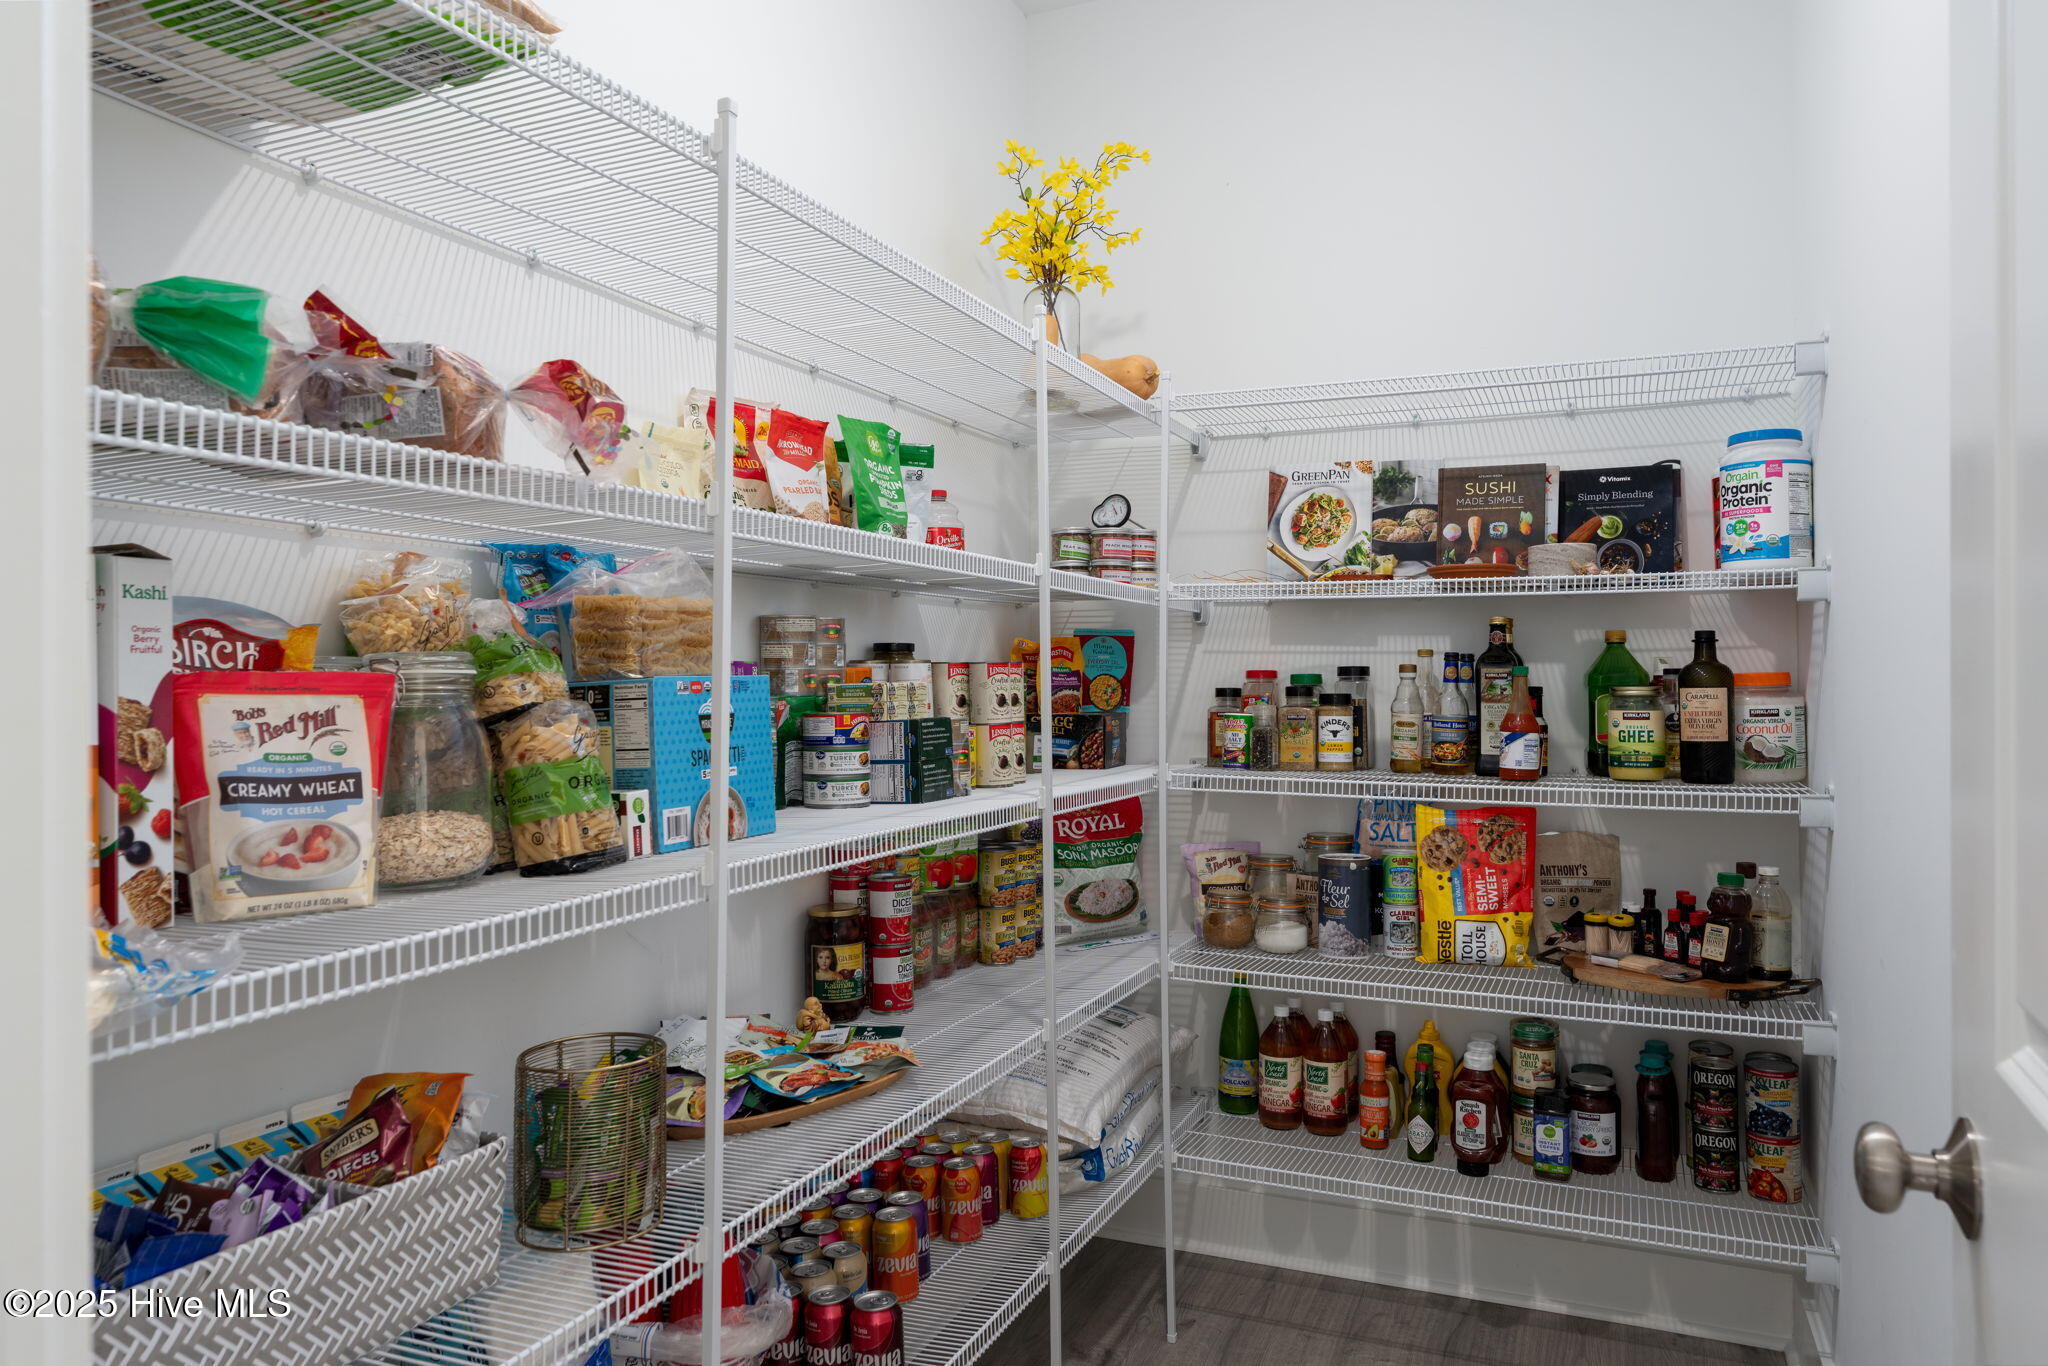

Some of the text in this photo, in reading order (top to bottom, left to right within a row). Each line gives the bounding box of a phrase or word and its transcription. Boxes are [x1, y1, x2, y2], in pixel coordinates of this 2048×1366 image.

[1726, 470, 1760, 484] Orgain
[1465, 481, 1516, 495] SUSHI
[1720, 480, 1773, 498] Organic
[1456, 496, 1524, 506] MADE SIMPLE
[1578, 490, 1654, 502] Simply Blending
[1722, 494, 1769, 510] Protein
[936, 533, 960, 545] Orville
[122, 584, 168, 600] Kashi
[130, 625, 161, 634] Organic
[132, 634, 160, 645] Berry
[130, 645, 163, 654] Fruitful
[255, 704, 338, 748] Red Mill
[1736, 722, 1792, 734] Coconut Oil
[1283, 729, 1310, 740] Organic
[1618, 730, 1654, 743] GHEE
[268, 754, 308, 762] ORGANIC
[246, 765, 332, 774] READY IN 5 MINUTES
[227, 778, 356, 798] CREAMY WHEAT
[261, 804, 326, 816] HOT CEREAL
[1056, 813, 1126, 839] ROYAL
[1369, 822, 1417, 842] SALT
[1091, 840, 1126, 848] ORGANIC
[1057, 848, 1088, 861] SONA
[1212, 856, 1242, 872] Red Mill
[1540, 864, 1588, 876] ANTHONY'S
[1320, 878, 1350, 894] Fleur
[1485, 868, 1498, 910] SWEET
[1476, 874, 1488, 911] SEMI-
[1322, 894, 1350, 908] de Sel
[1462, 932, 1473, 960] TOLL
[824, 981, 855, 990] Kalamata
[1519, 1051, 1540, 1062] SANTA
[1266, 1062, 1286, 1072] North
[1520, 1060, 1538, 1068] CRUZ
[1266, 1070, 1284, 1079] Coast
[1308, 1066, 1326, 1077] North
[1308, 1074, 1326, 1083] Coast
[1694, 1070, 1736, 1088] OREGON
[1768, 1079, 1790, 1090] LEAF
[1262, 1096, 1290, 1107] VINEGAR
[1460, 1106, 1482, 1114] Kitchen
[266, 1121, 279, 1129] OPEN
[324, 1122, 374, 1162] SNYDER'S
[1695, 1132, 1736, 1151] OREGON
[190, 1146, 204, 1154] OPEN
[1762, 1146, 1784, 1156] LEAF
[326, 1150, 380, 1181] PIECES
[876, 1252, 917, 1274] zevia
[806, 1342, 850, 1366] zevia
